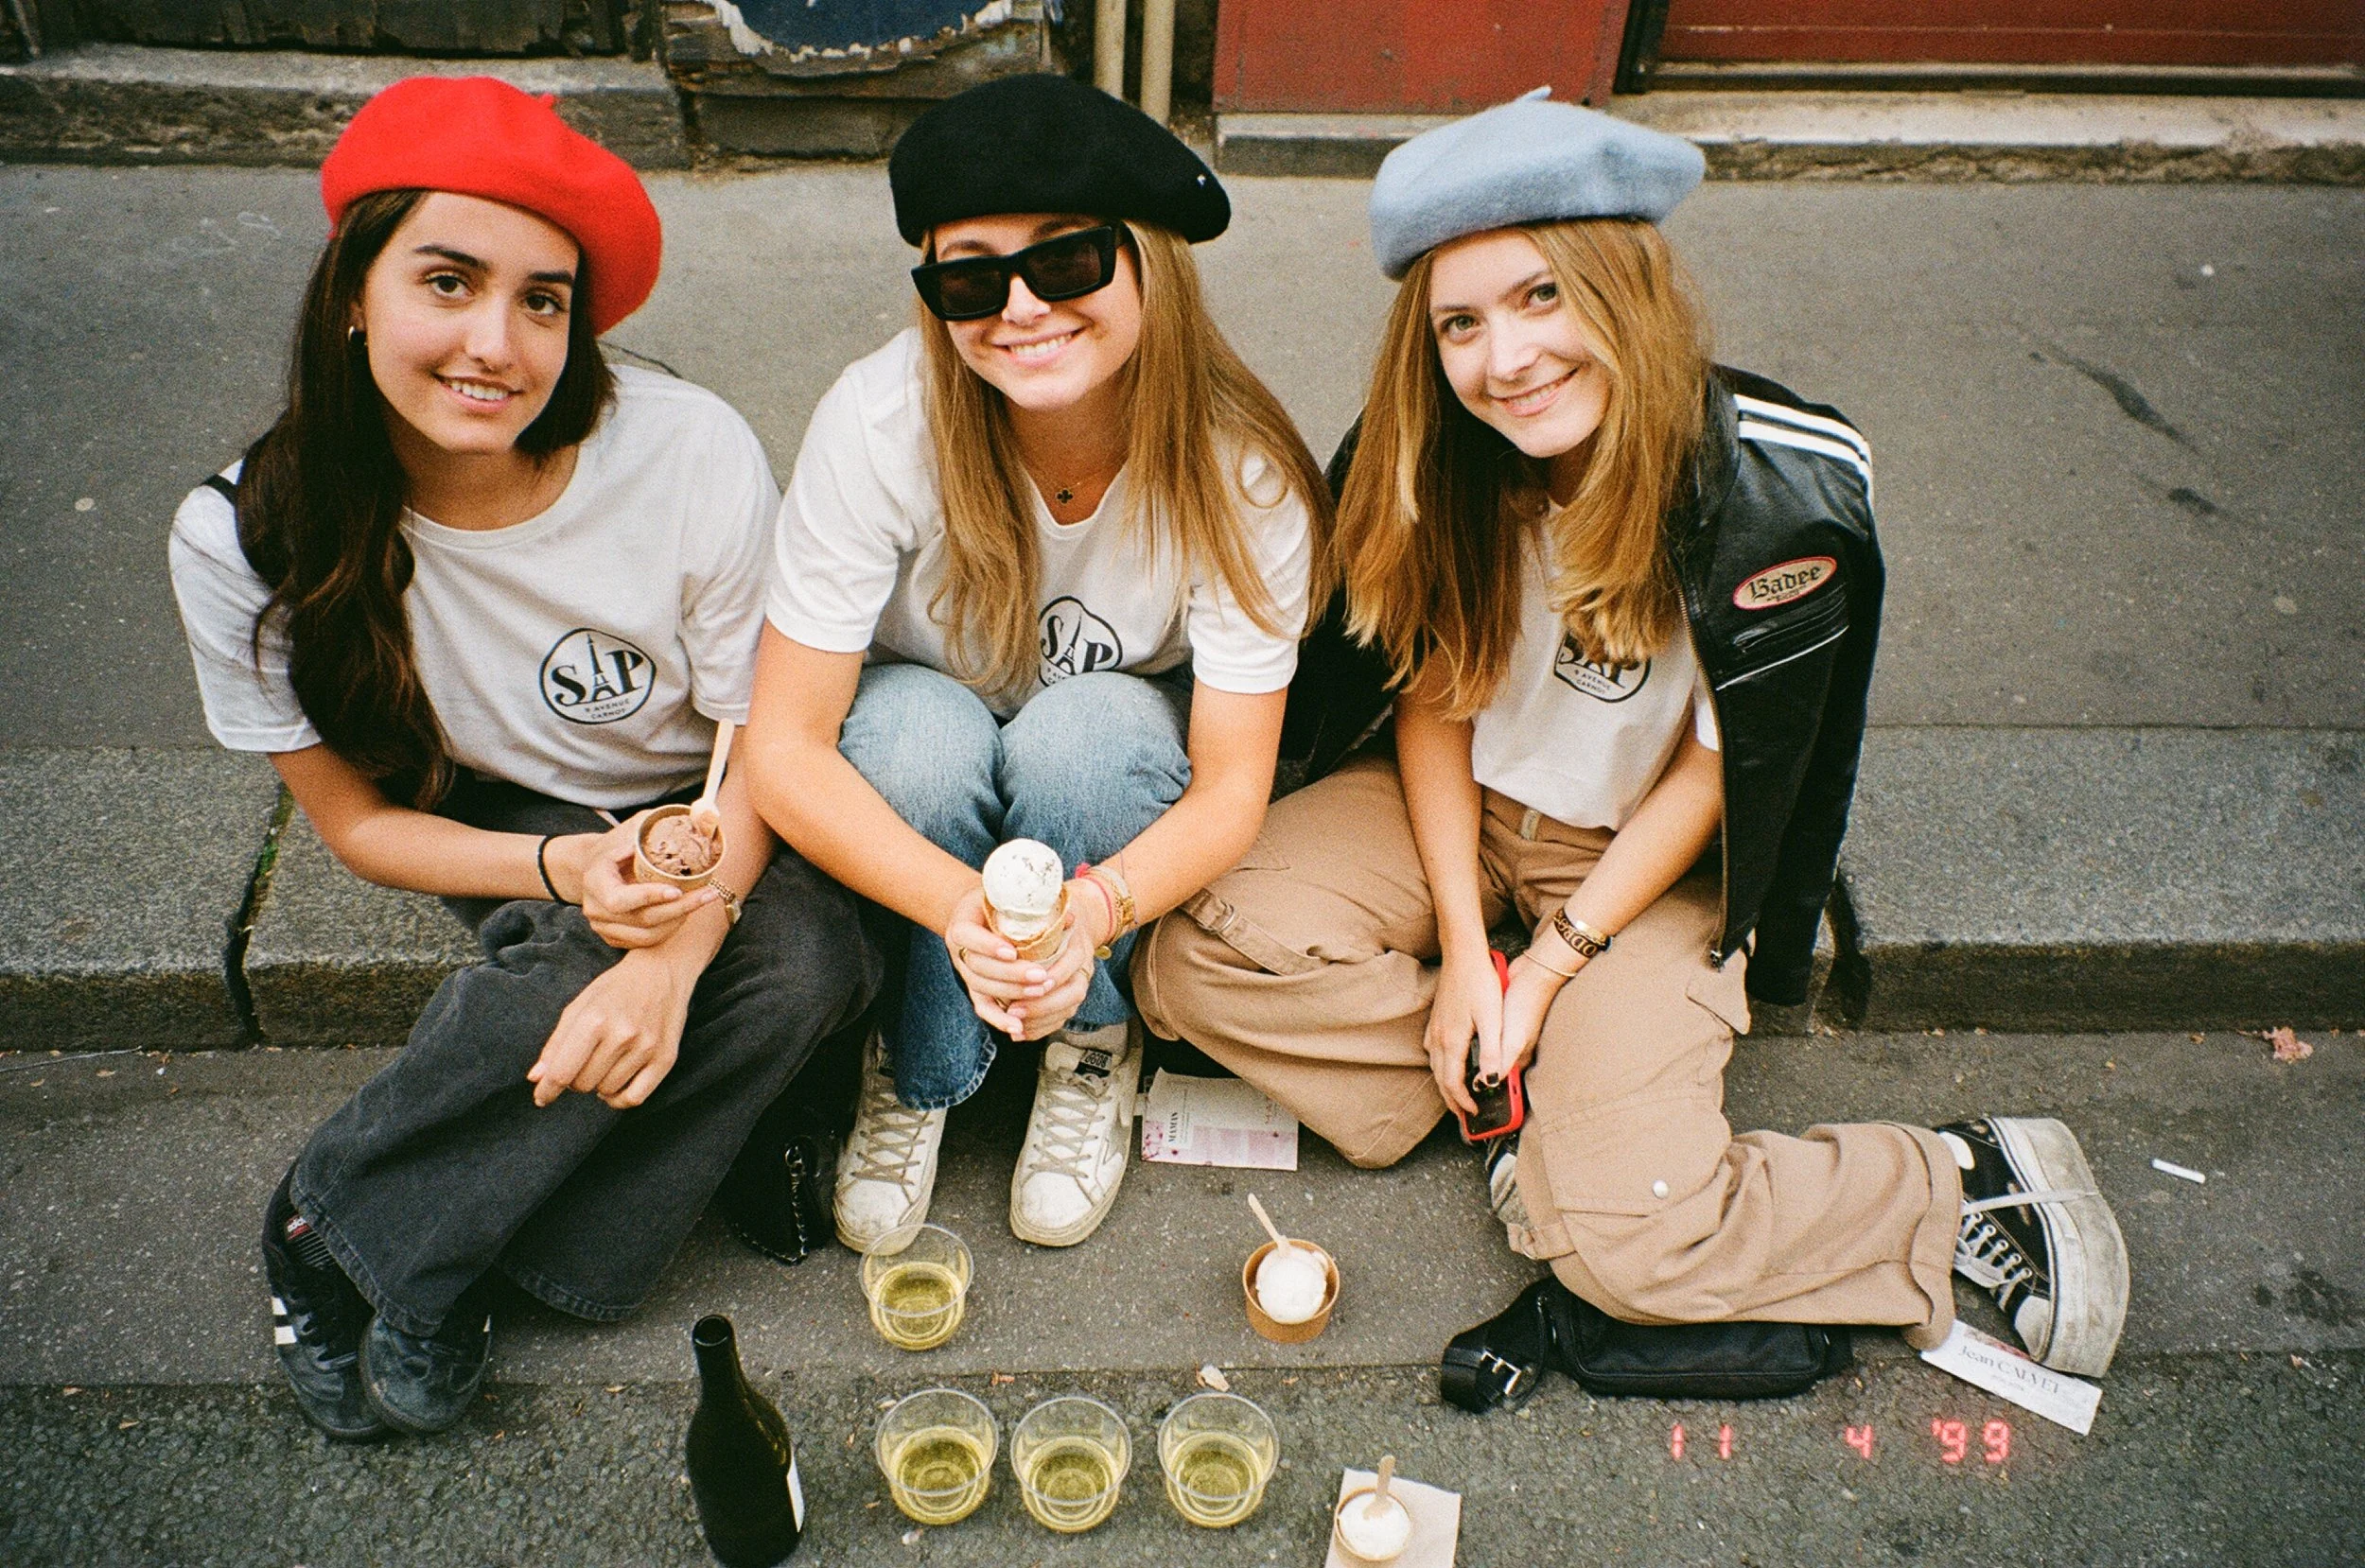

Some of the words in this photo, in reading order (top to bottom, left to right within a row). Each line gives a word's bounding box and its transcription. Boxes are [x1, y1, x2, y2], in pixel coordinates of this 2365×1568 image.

[551, 633, 644, 706] SAP
[594, 698, 630, 711] AVENUE
[1958, 1345, 1994, 1368] Jean
